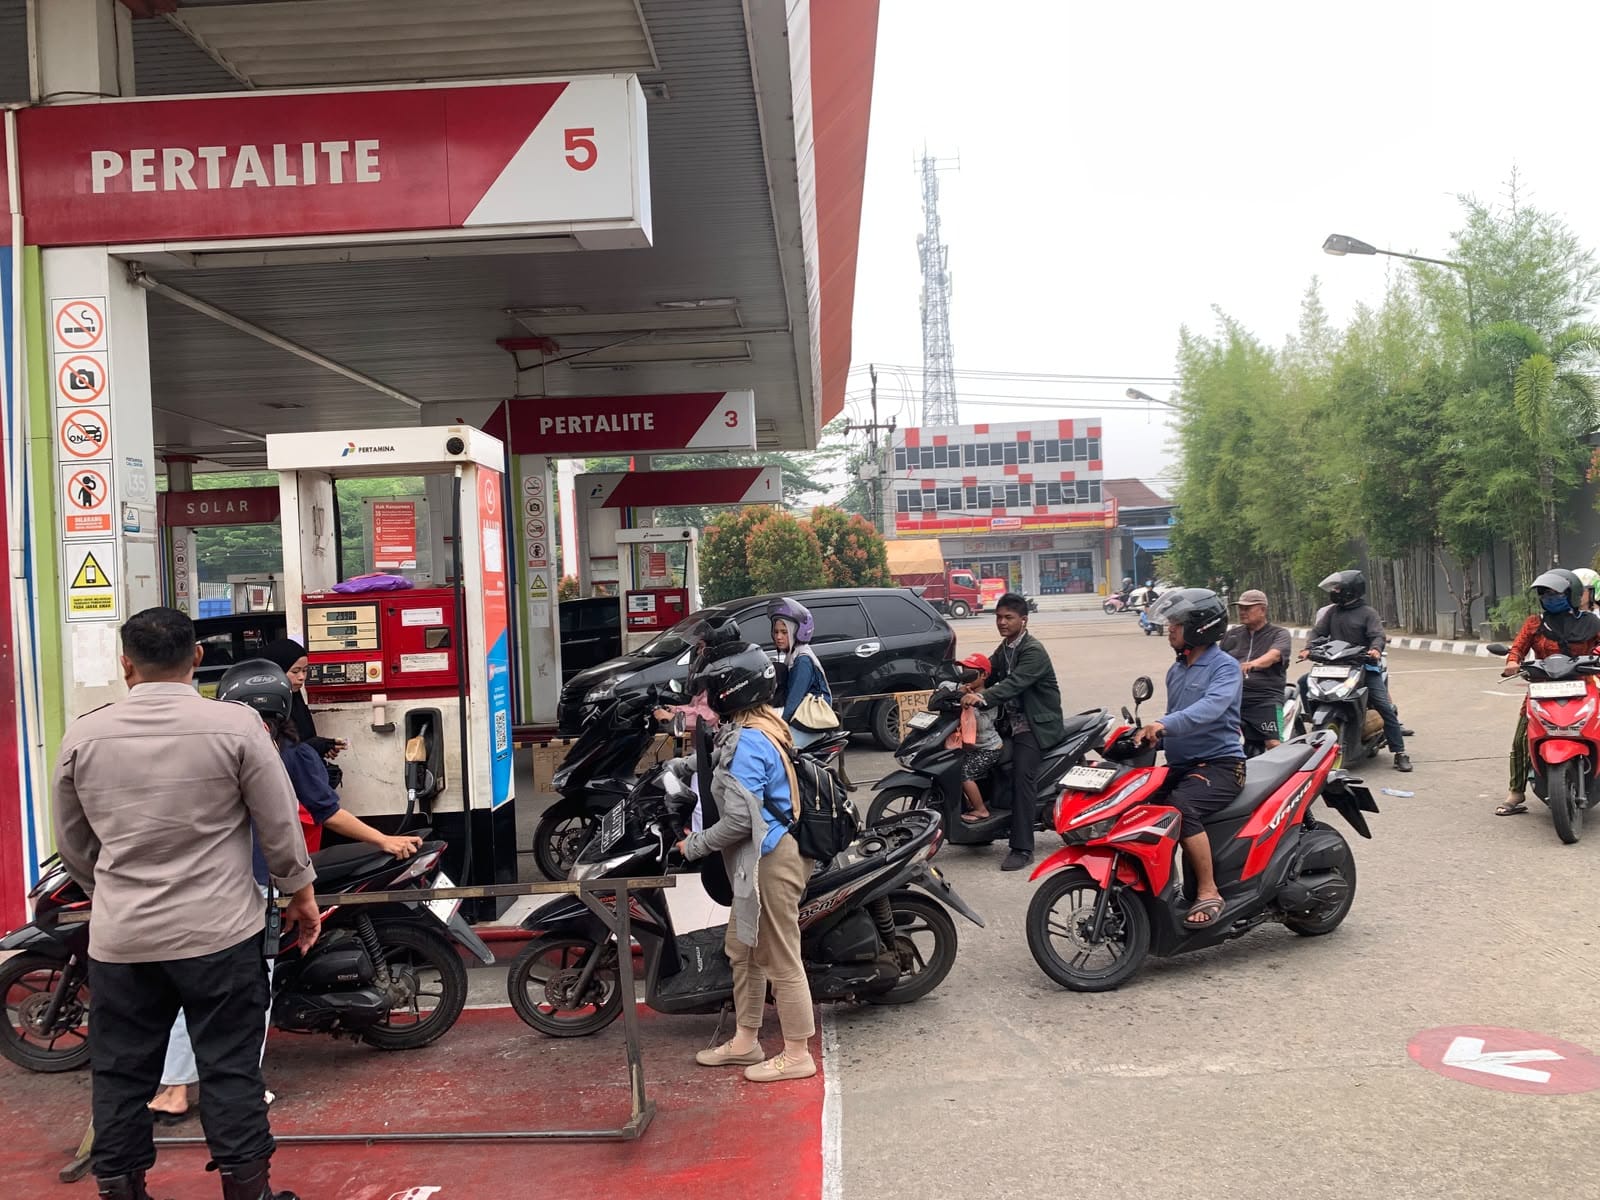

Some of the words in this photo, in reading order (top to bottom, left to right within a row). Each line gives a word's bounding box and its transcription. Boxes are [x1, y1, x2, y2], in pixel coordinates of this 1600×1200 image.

[564, 127, 598, 172] 5
[91, 138, 382, 194] PERTALITE
[539, 412, 655, 435] PERTALITE
[724, 410, 738, 427] 3
[358, 445, 395, 453] PERTAMINA
[765, 478, 771, 490] 1
[186, 500, 249, 514] SOLAR
[1269, 779, 1313, 830] VARIO
